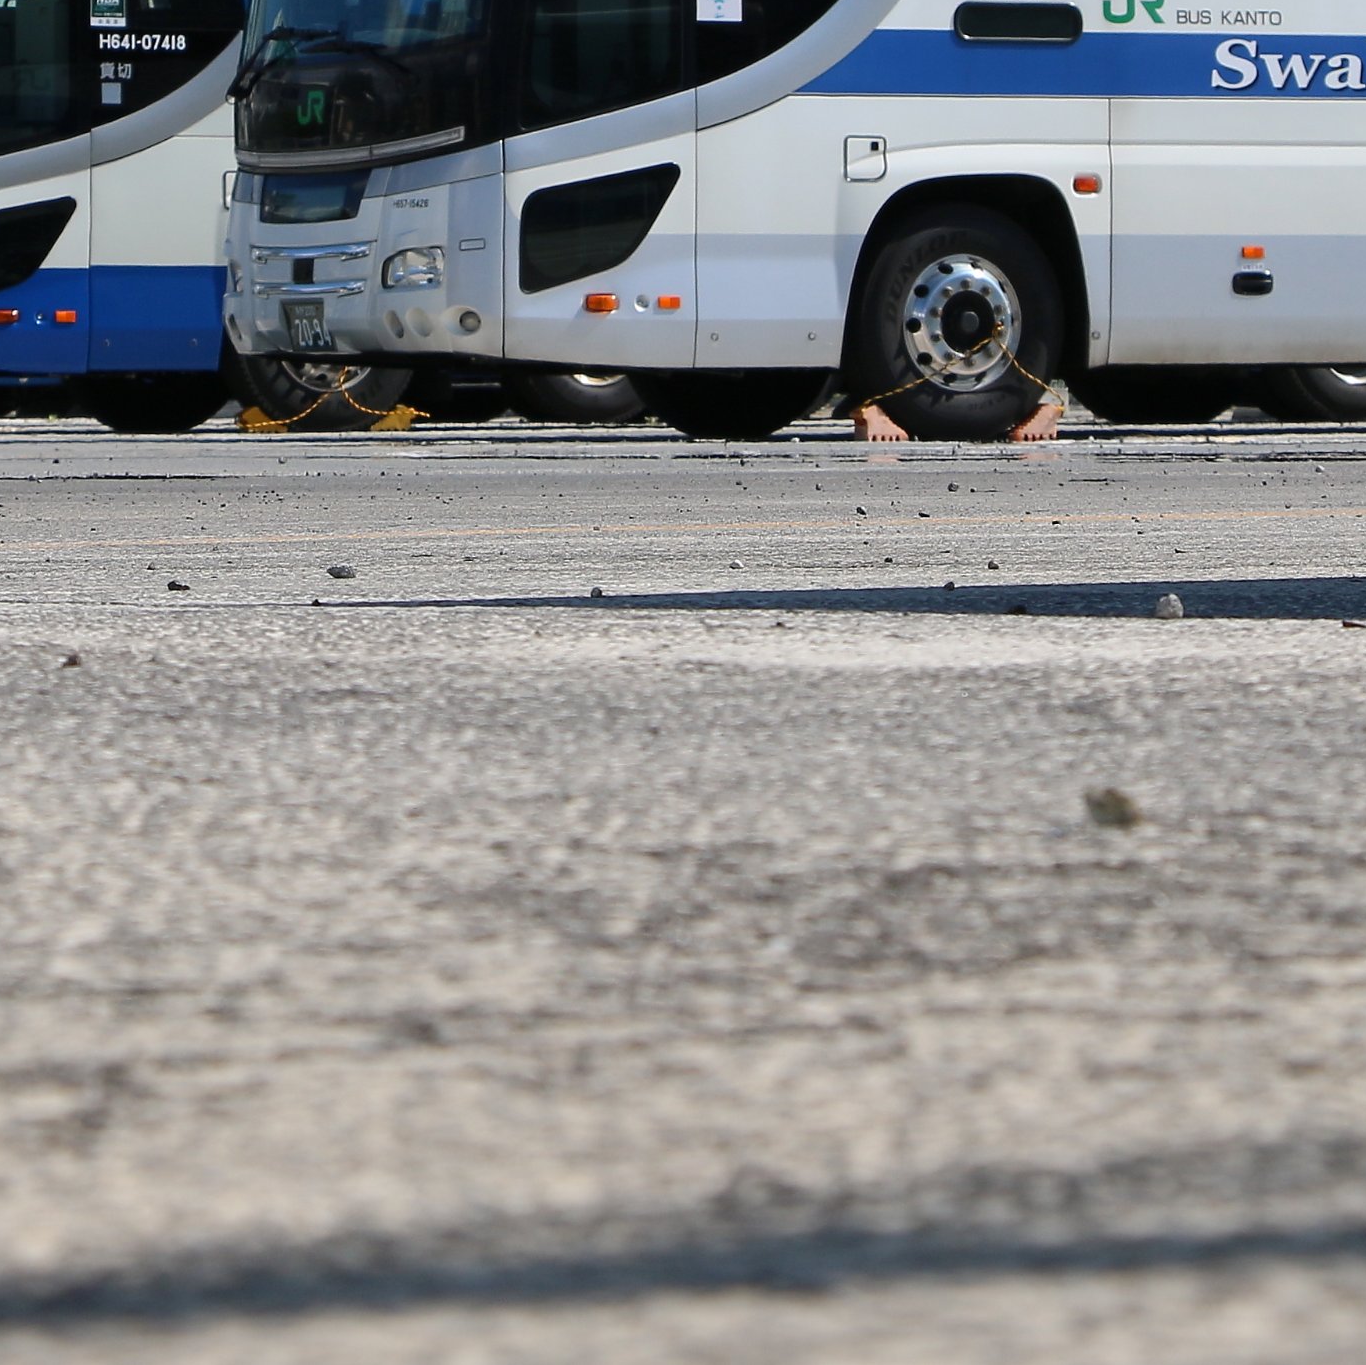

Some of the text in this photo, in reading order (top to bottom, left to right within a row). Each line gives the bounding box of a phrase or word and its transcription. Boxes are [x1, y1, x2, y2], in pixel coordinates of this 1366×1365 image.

[1176, 9, 1212, 25] BUS
[1221, 10, 1283, 26] KANTO
[99, 33, 186, 51] H641-07418
[100, 61, 132, 79] 貸切
[297, 90, 325, 125] JR
